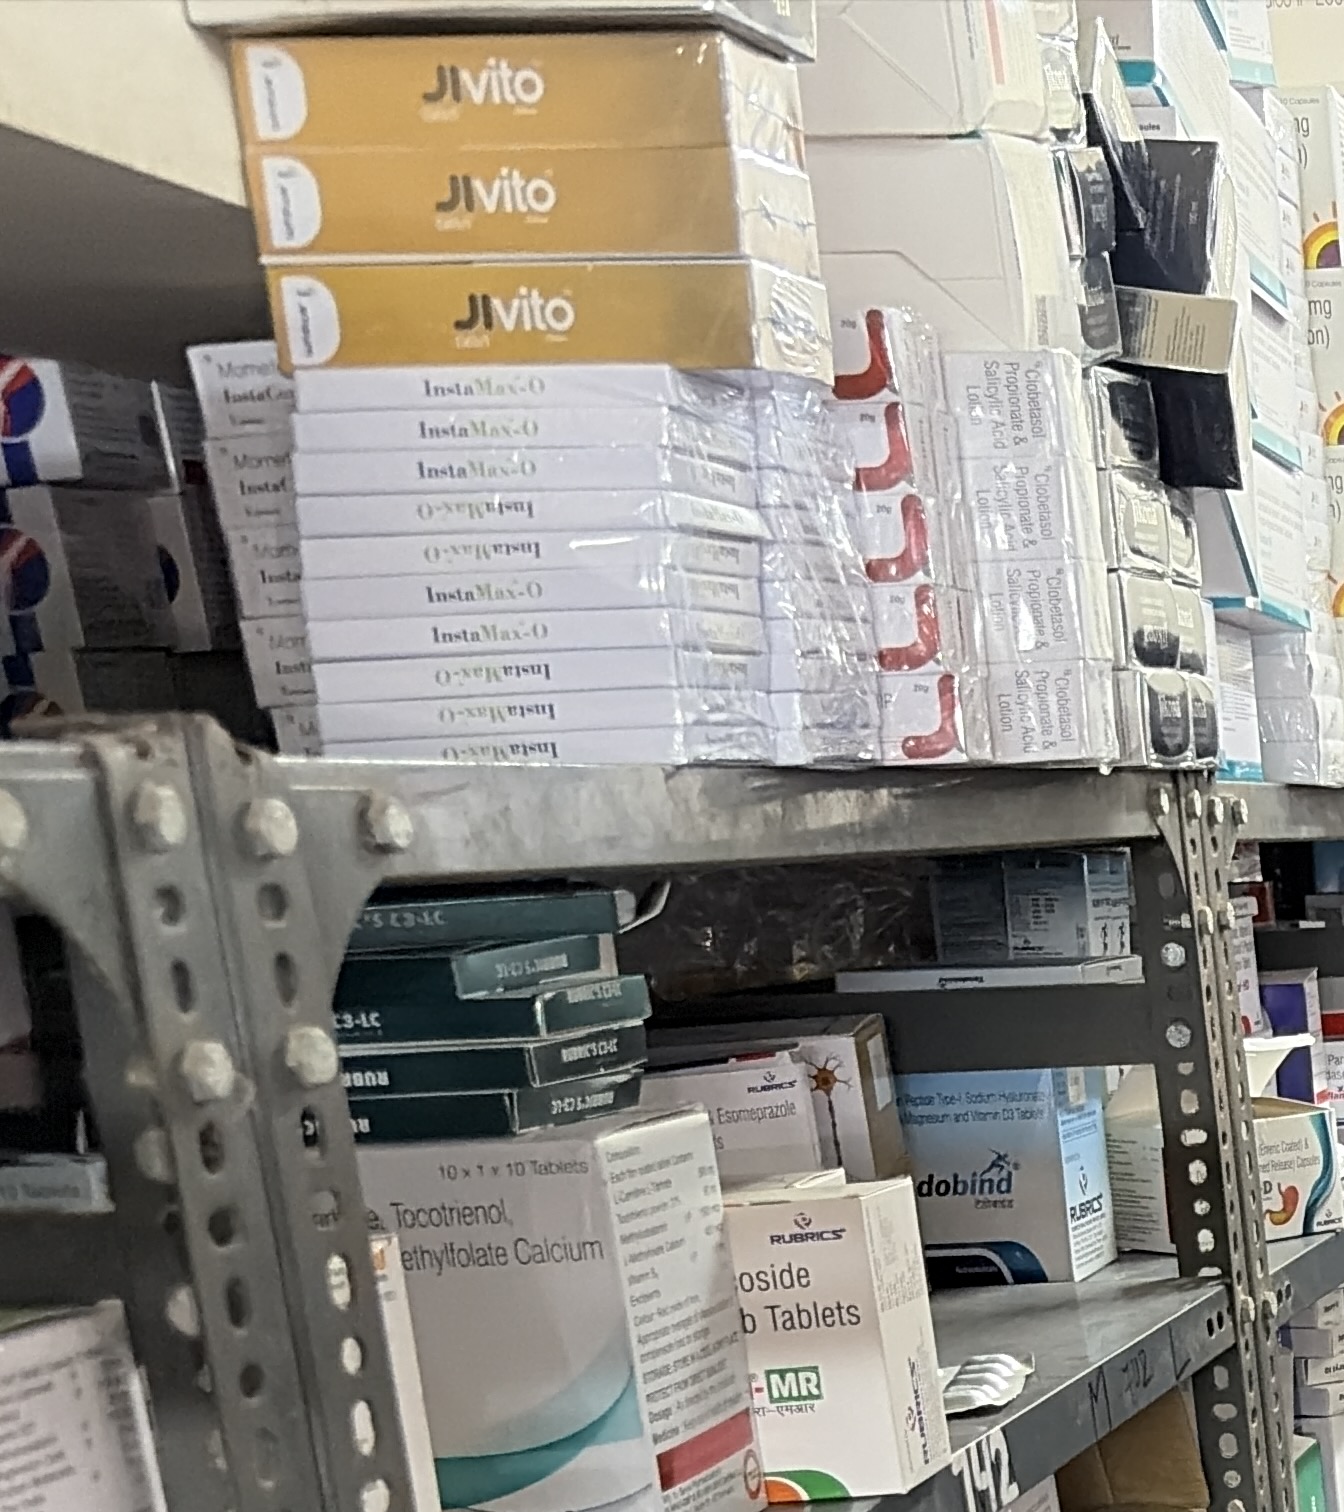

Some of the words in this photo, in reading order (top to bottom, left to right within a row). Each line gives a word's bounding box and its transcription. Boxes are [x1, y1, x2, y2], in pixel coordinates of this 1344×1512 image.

[1309, 298, 1332, 319] mg
[1005, 361, 1021, 434] Propionate
[1014, 465, 1033, 537] Propionate
[746, 1080, 797, 1094] RUBRICS
[718, 1100, 797, 1125] Esomeprazole
[440, 1165, 457, 1180] 10
[507, 1162, 525, 1177] 10
[530, 1159, 589, 1174] Tablets
[393, 1202, 513, 1228] Tocotrienol,
[1069, 1196, 1104, 1225] RUBRICS
[769, 1228, 846, 1246] RUBRICS
[515, 1238, 604, 1265] Calcium
[765, 1301, 862, 1333] Tablets
[768, 1369, 820, 1399] MR
